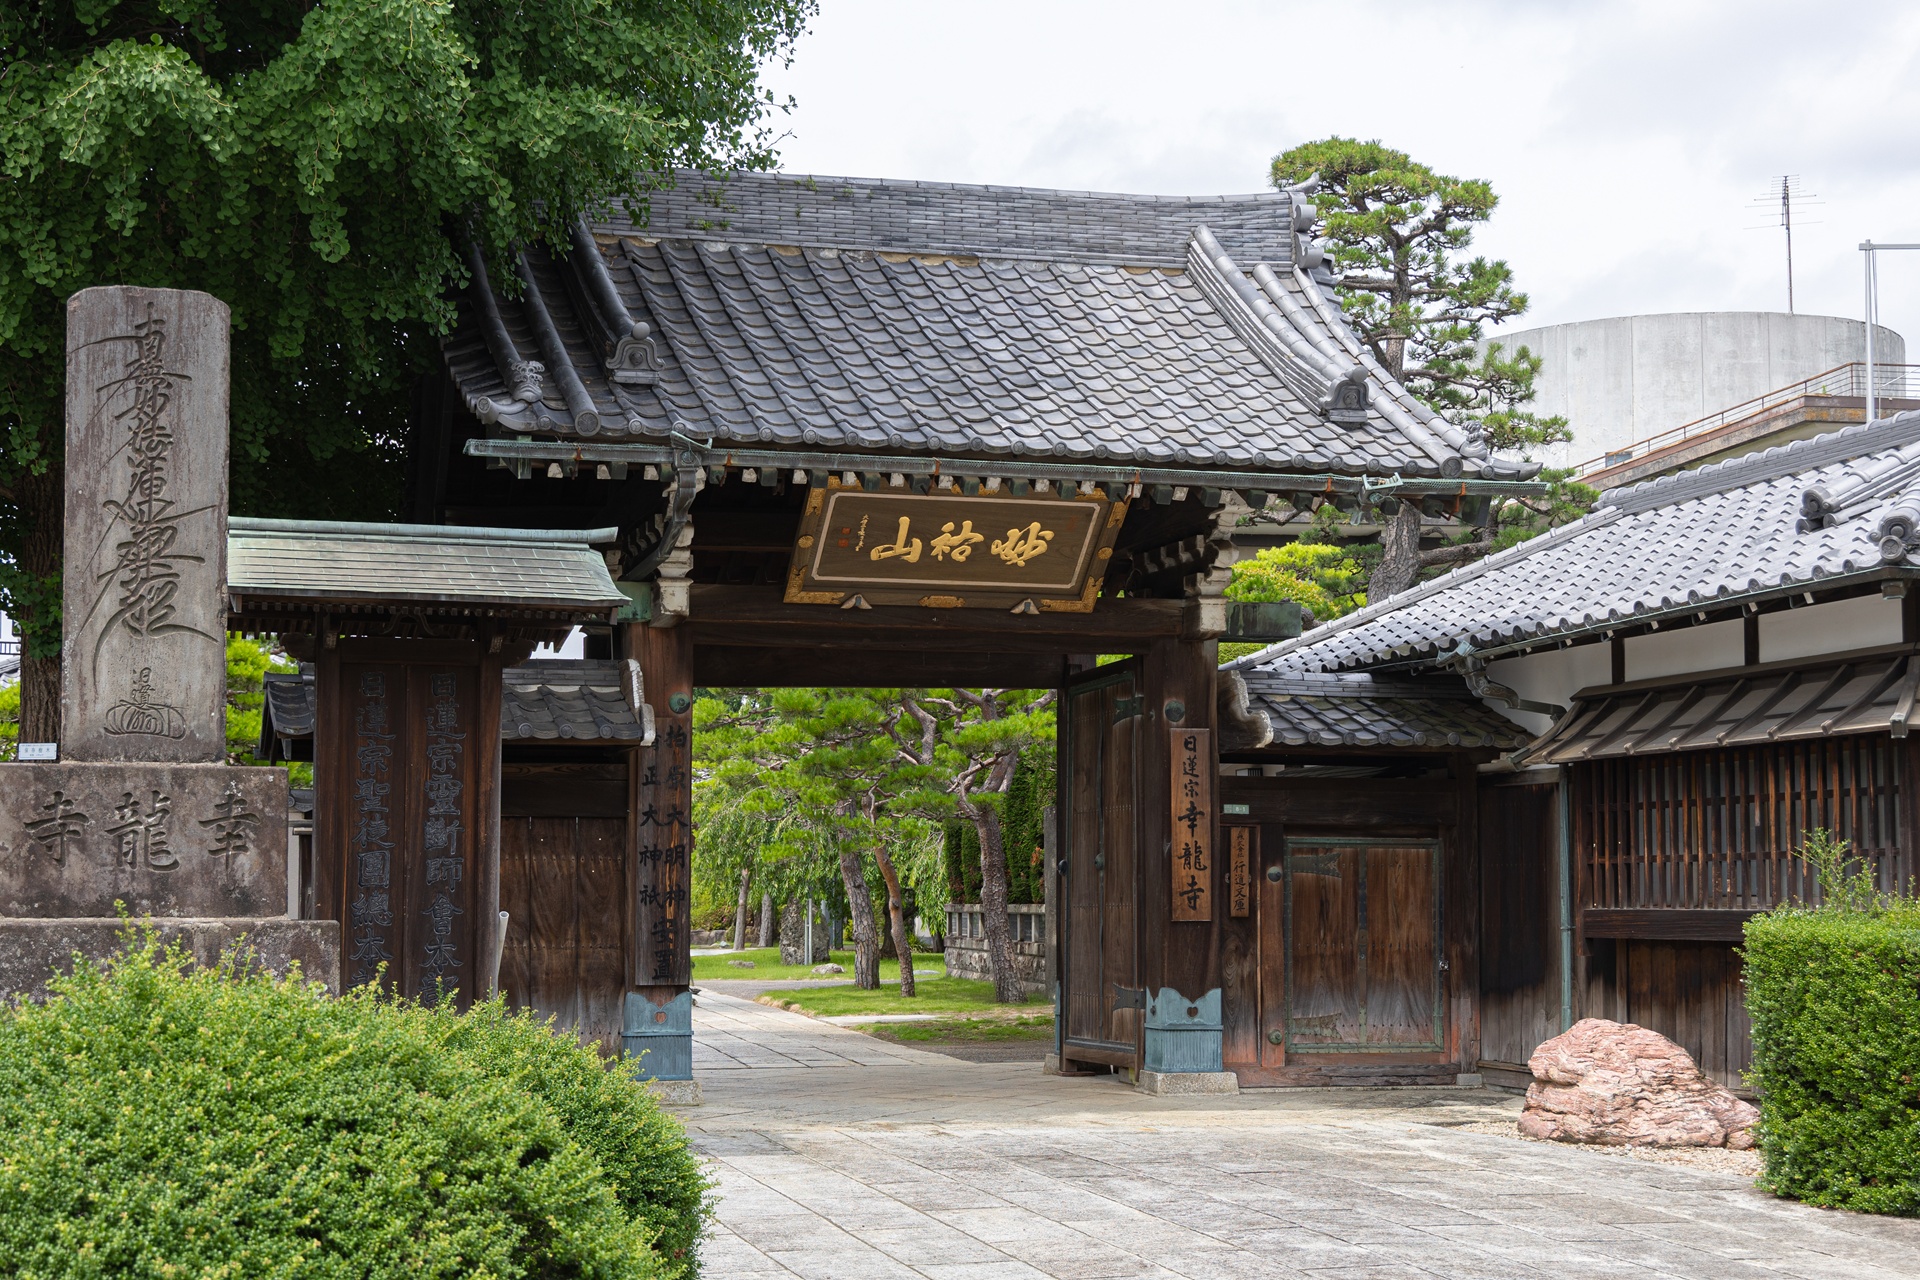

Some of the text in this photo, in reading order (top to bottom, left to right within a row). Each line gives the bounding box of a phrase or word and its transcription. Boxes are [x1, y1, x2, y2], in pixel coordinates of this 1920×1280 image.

[24, 790, 260, 886] 幸龍寺
[1177, 736, 1207, 910] 日蓮宗幸龍寺
[651, 919, 677, 980] 安置
